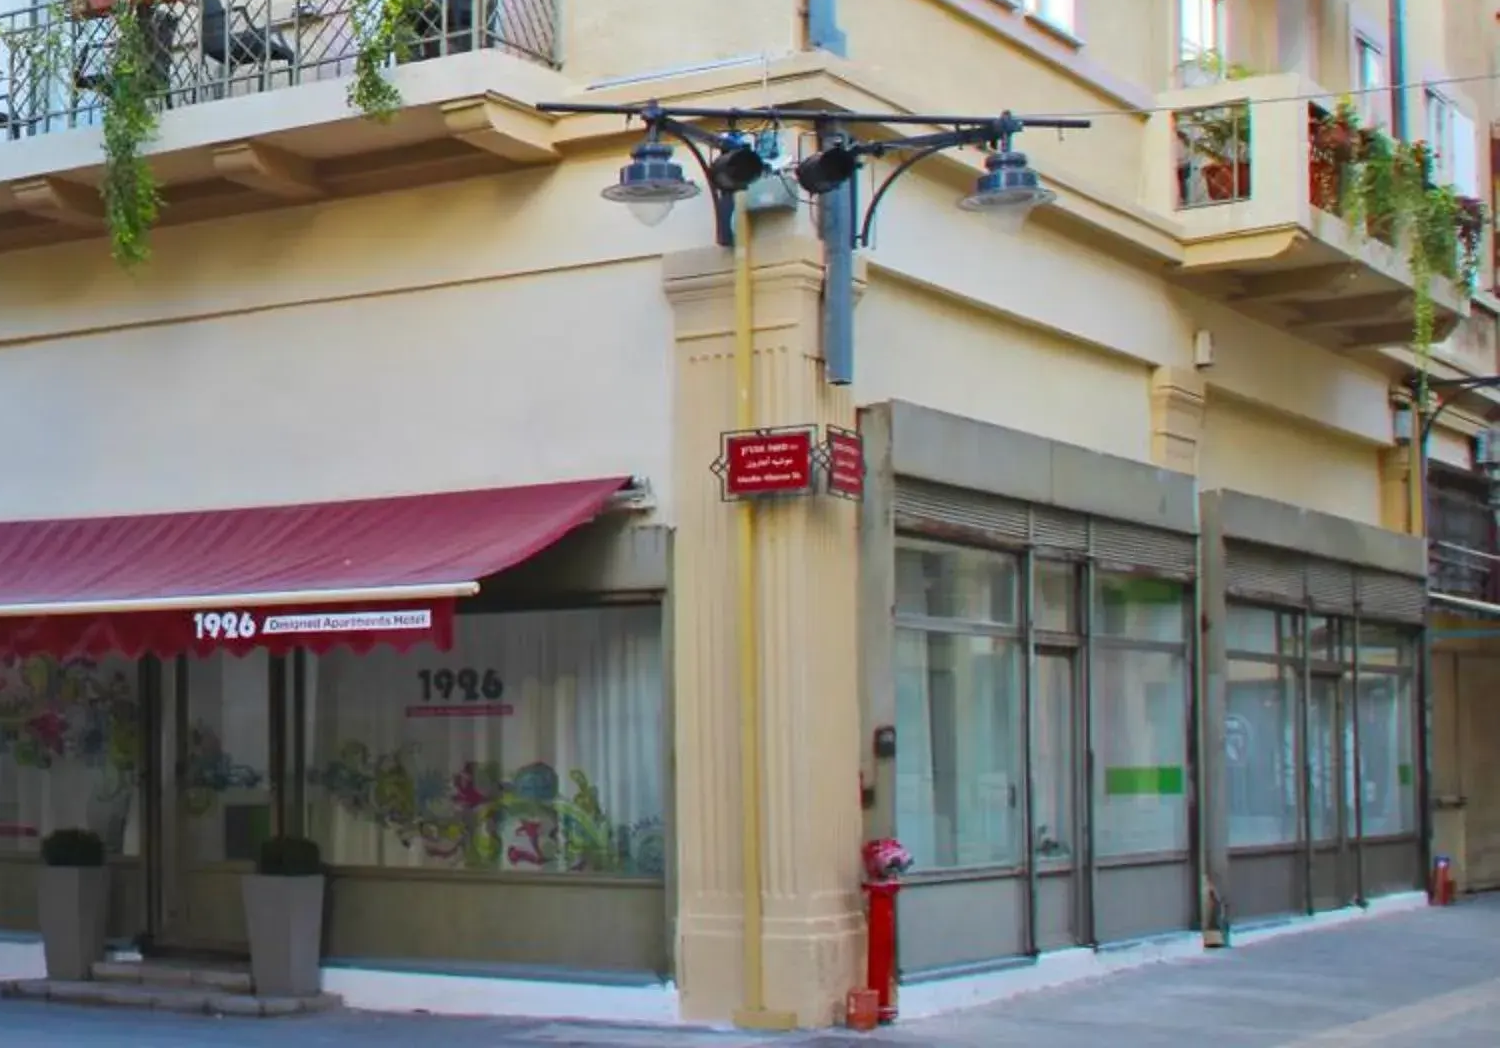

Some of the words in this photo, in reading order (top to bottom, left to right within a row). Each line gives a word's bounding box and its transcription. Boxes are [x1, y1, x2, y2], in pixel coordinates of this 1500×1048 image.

[193, 611, 256, 639] 1926
[270, 617, 320, 631] Designed
[323, 615, 391, 629] Apartments
[393, 613, 426, 626] Hotel
[417, 667, 504, 701] 1926
